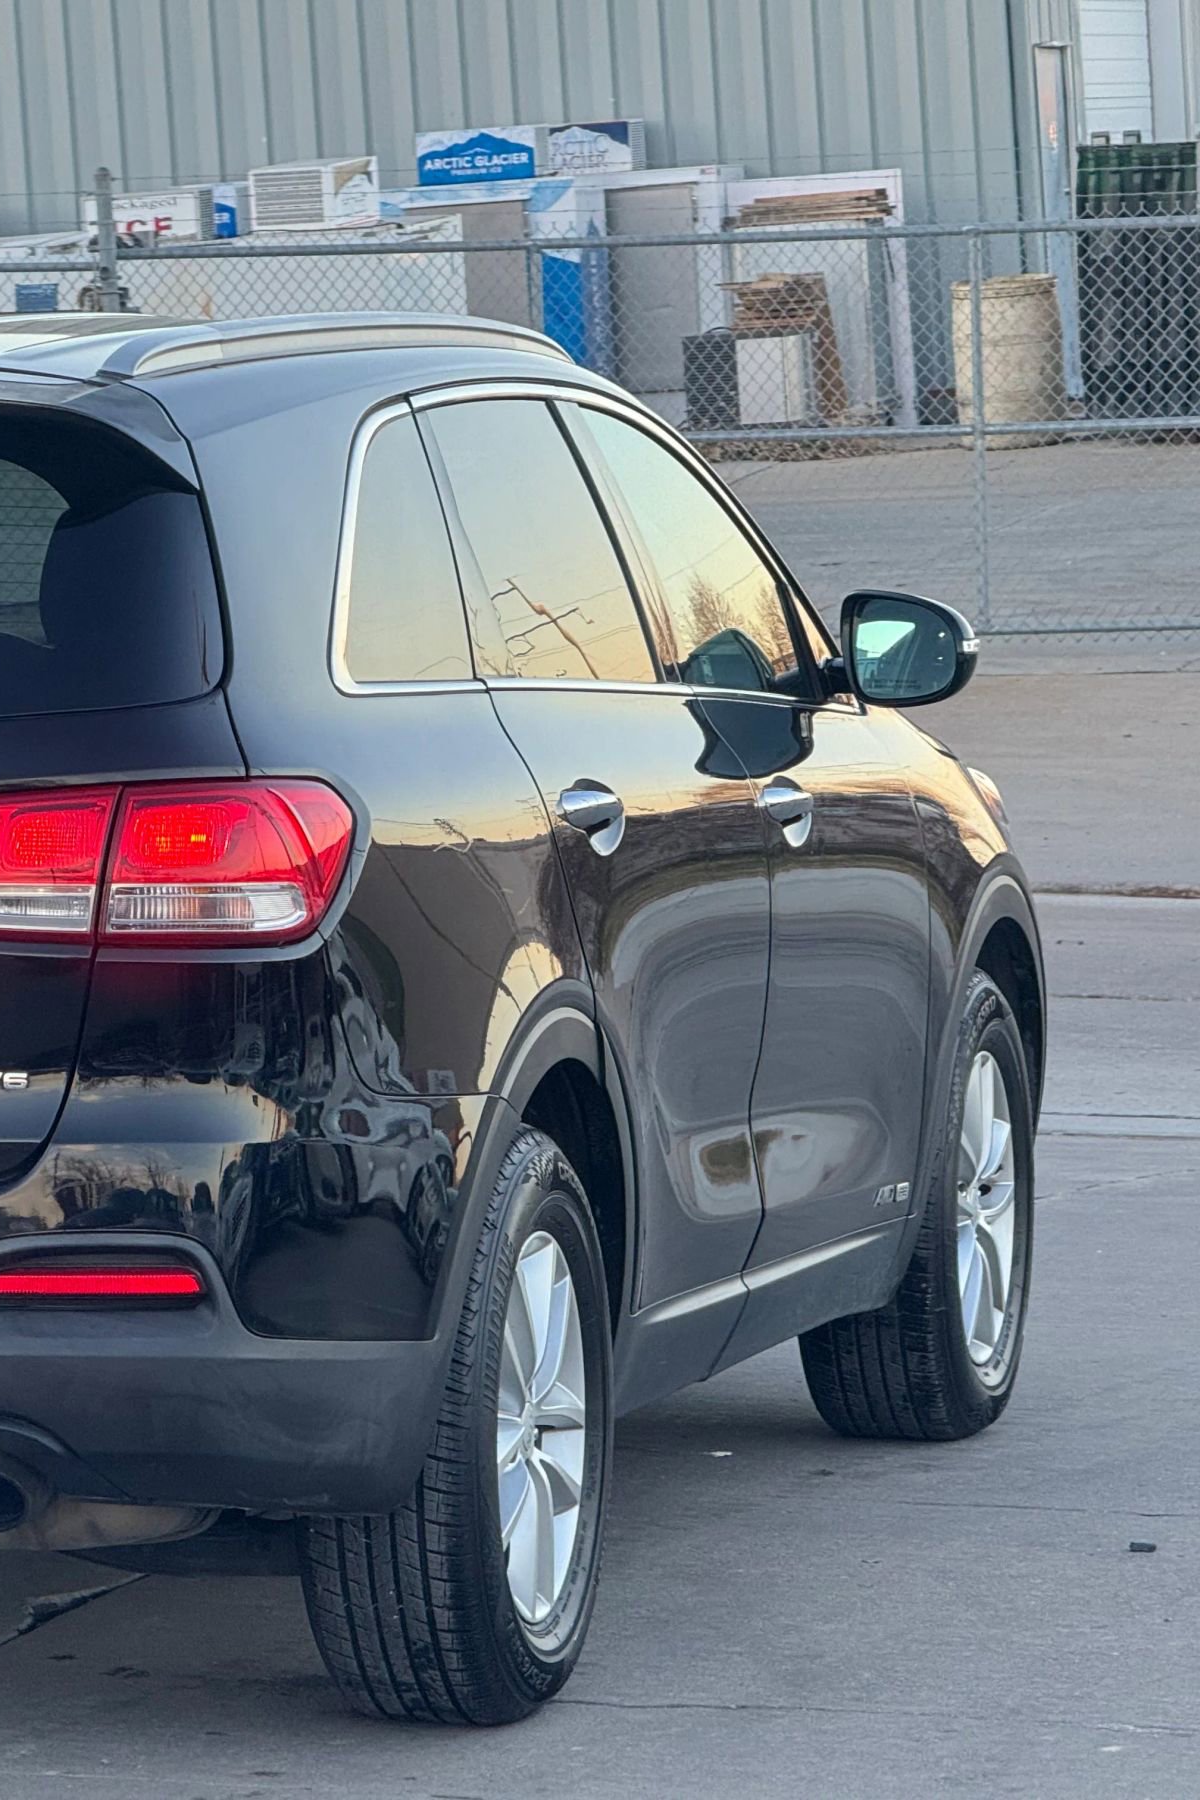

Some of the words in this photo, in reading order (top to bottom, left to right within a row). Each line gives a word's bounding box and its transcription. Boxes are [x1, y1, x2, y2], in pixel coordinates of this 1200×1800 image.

[552, 135, 609, 156] RCTIC
[424, 156, 472, 170] ARCTIC
[474, 152, 529, 167] GLACIER
[551, 154, 609, 170] LACIER
